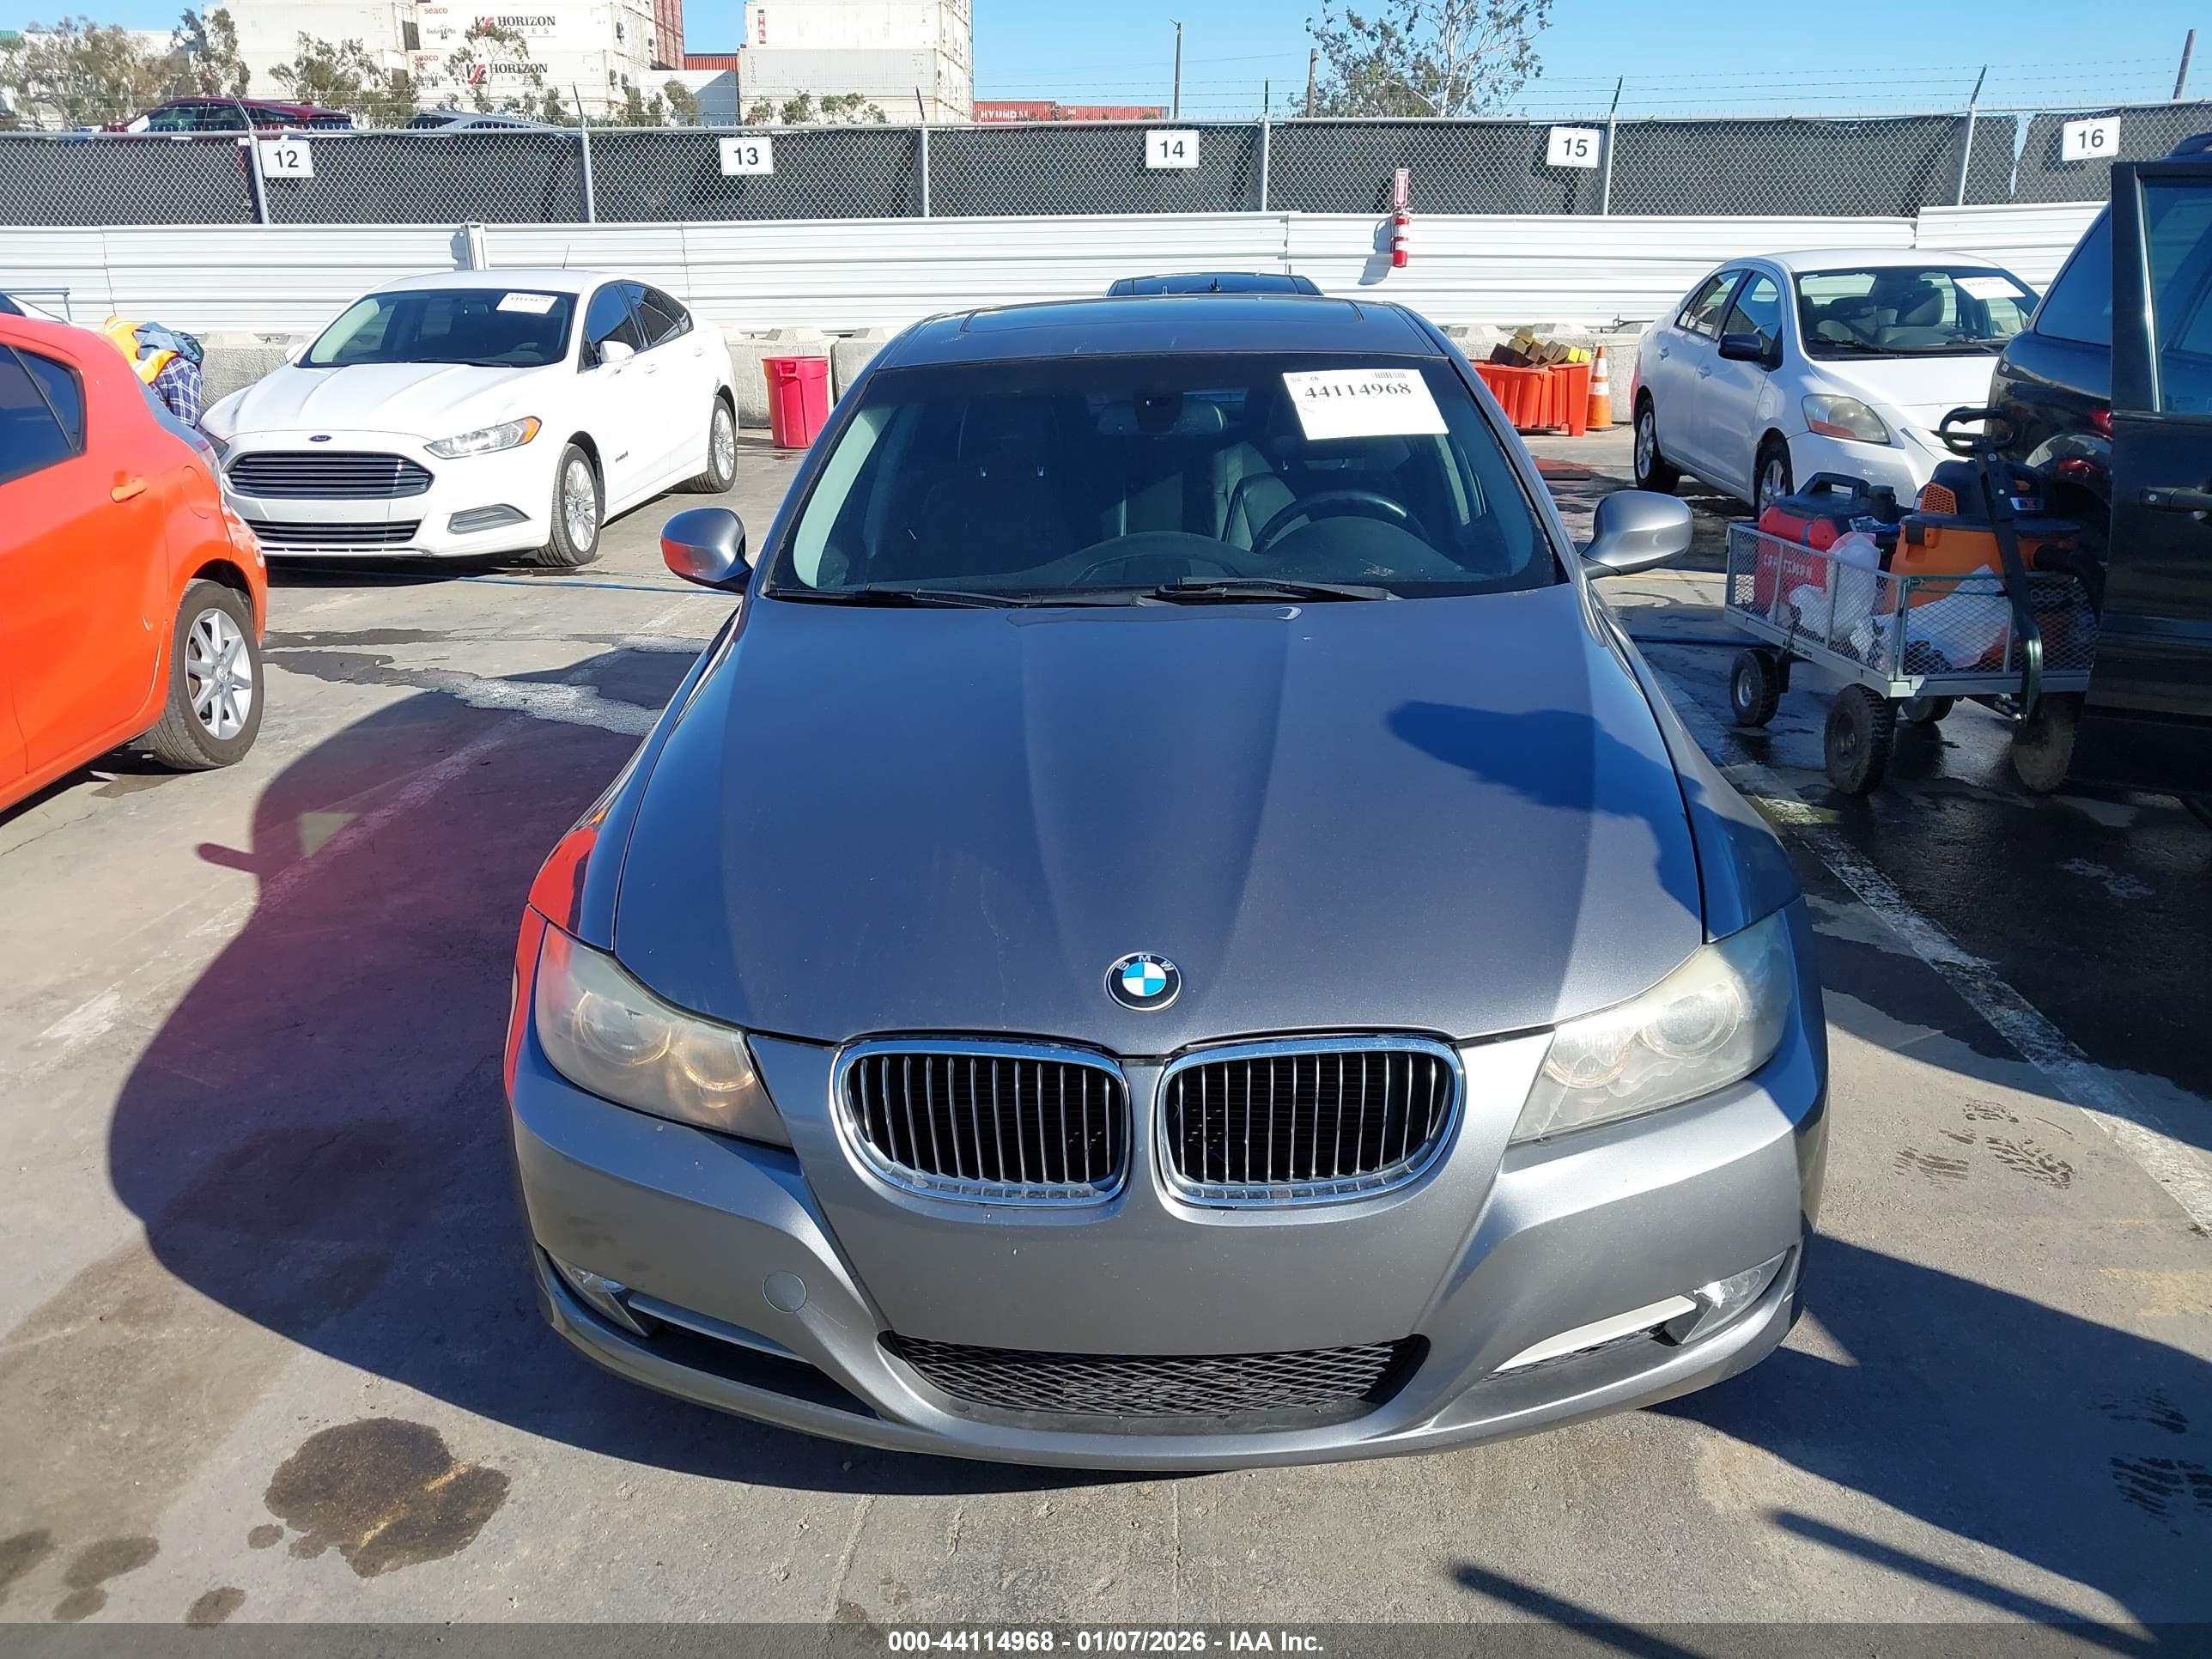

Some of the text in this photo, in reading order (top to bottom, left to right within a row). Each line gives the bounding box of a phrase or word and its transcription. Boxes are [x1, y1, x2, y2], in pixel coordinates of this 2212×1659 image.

[498, 15, 556, 27] HORIZON
[414, 53, 439, 62] seaco
[489, 63, 549, 74] HORIZON
[1563, 137, 1589, 158] 15
[2078, 129, 2104, 149] 16
[274, 149, 300, 168] 12
[733, 147, 759, 166] 13
[1159, 140, 1185, 159] 14
[1305, 383, 1412, 398] 44114968
[1116, 954, 1176, 972] BMW
